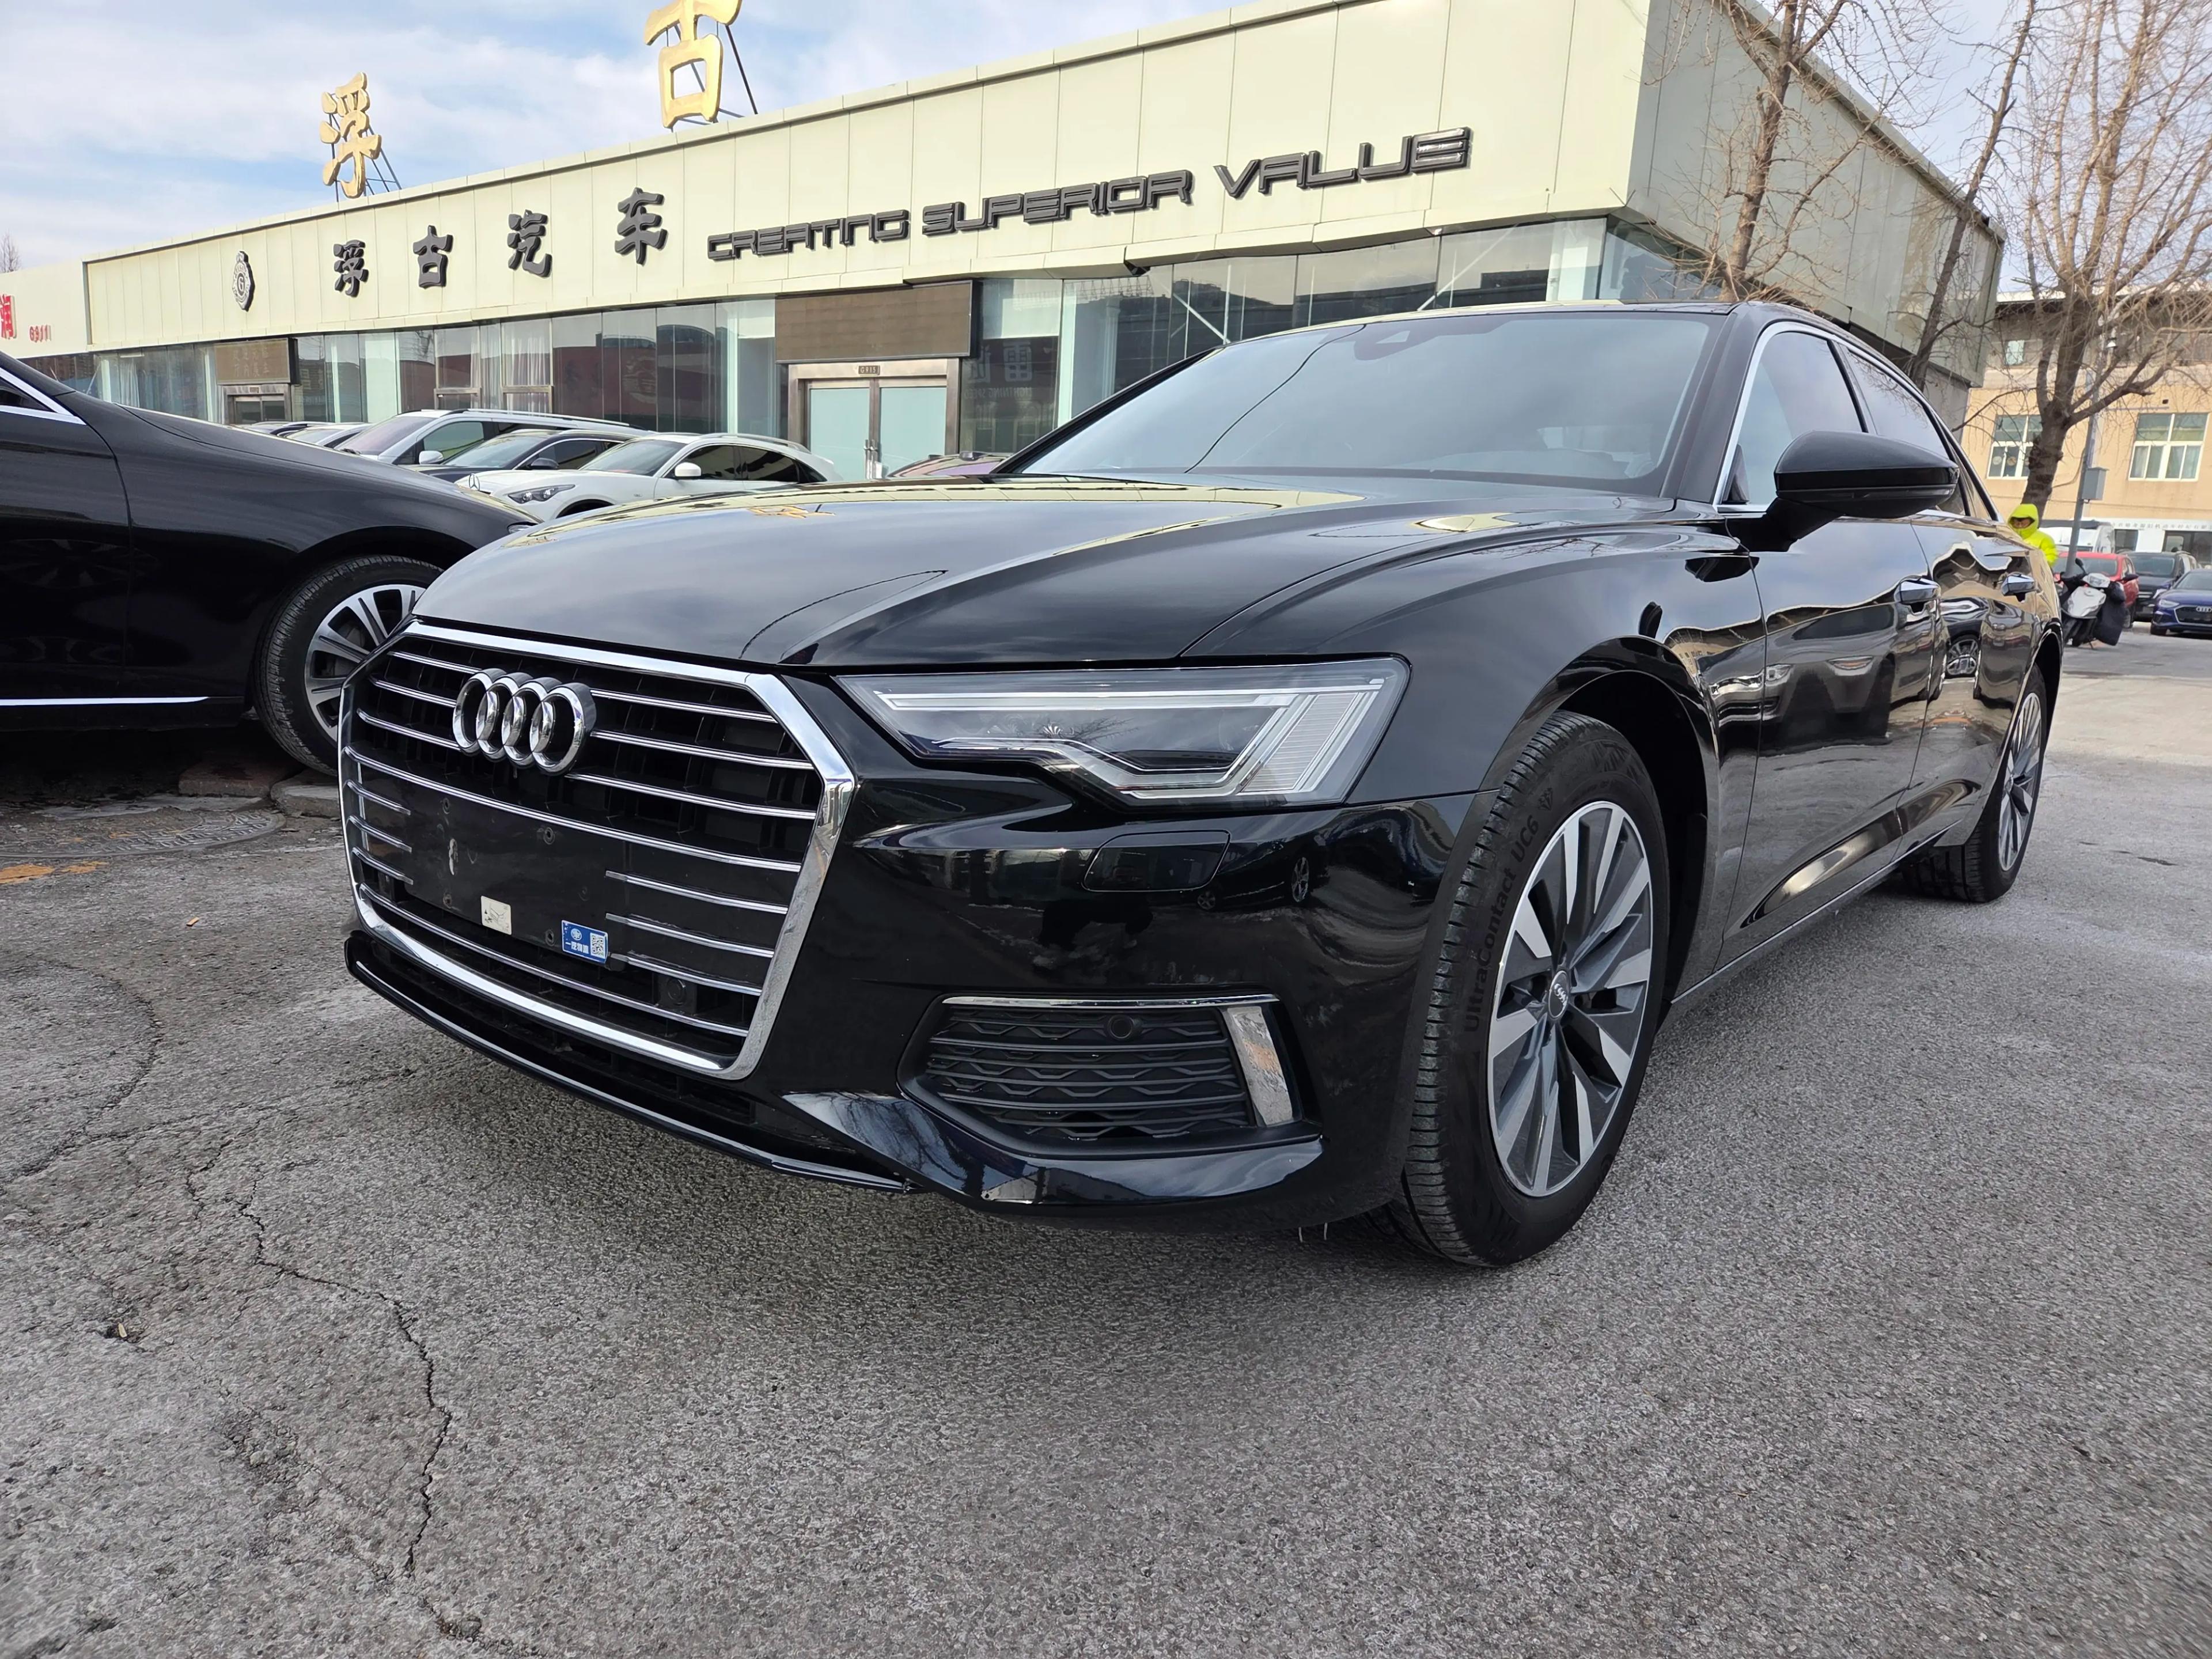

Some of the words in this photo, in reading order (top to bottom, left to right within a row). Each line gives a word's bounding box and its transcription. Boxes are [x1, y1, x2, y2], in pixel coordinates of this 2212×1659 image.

[922, 169, 1194, 237] SUPERIOR
[1213, 126, 1473, 199] VALUE
[333, 187, 668, 298] 浮古汽车
[1464, 867, 1517, 1033] UltraContact
[1510, 815, 1540, 863] UC6
